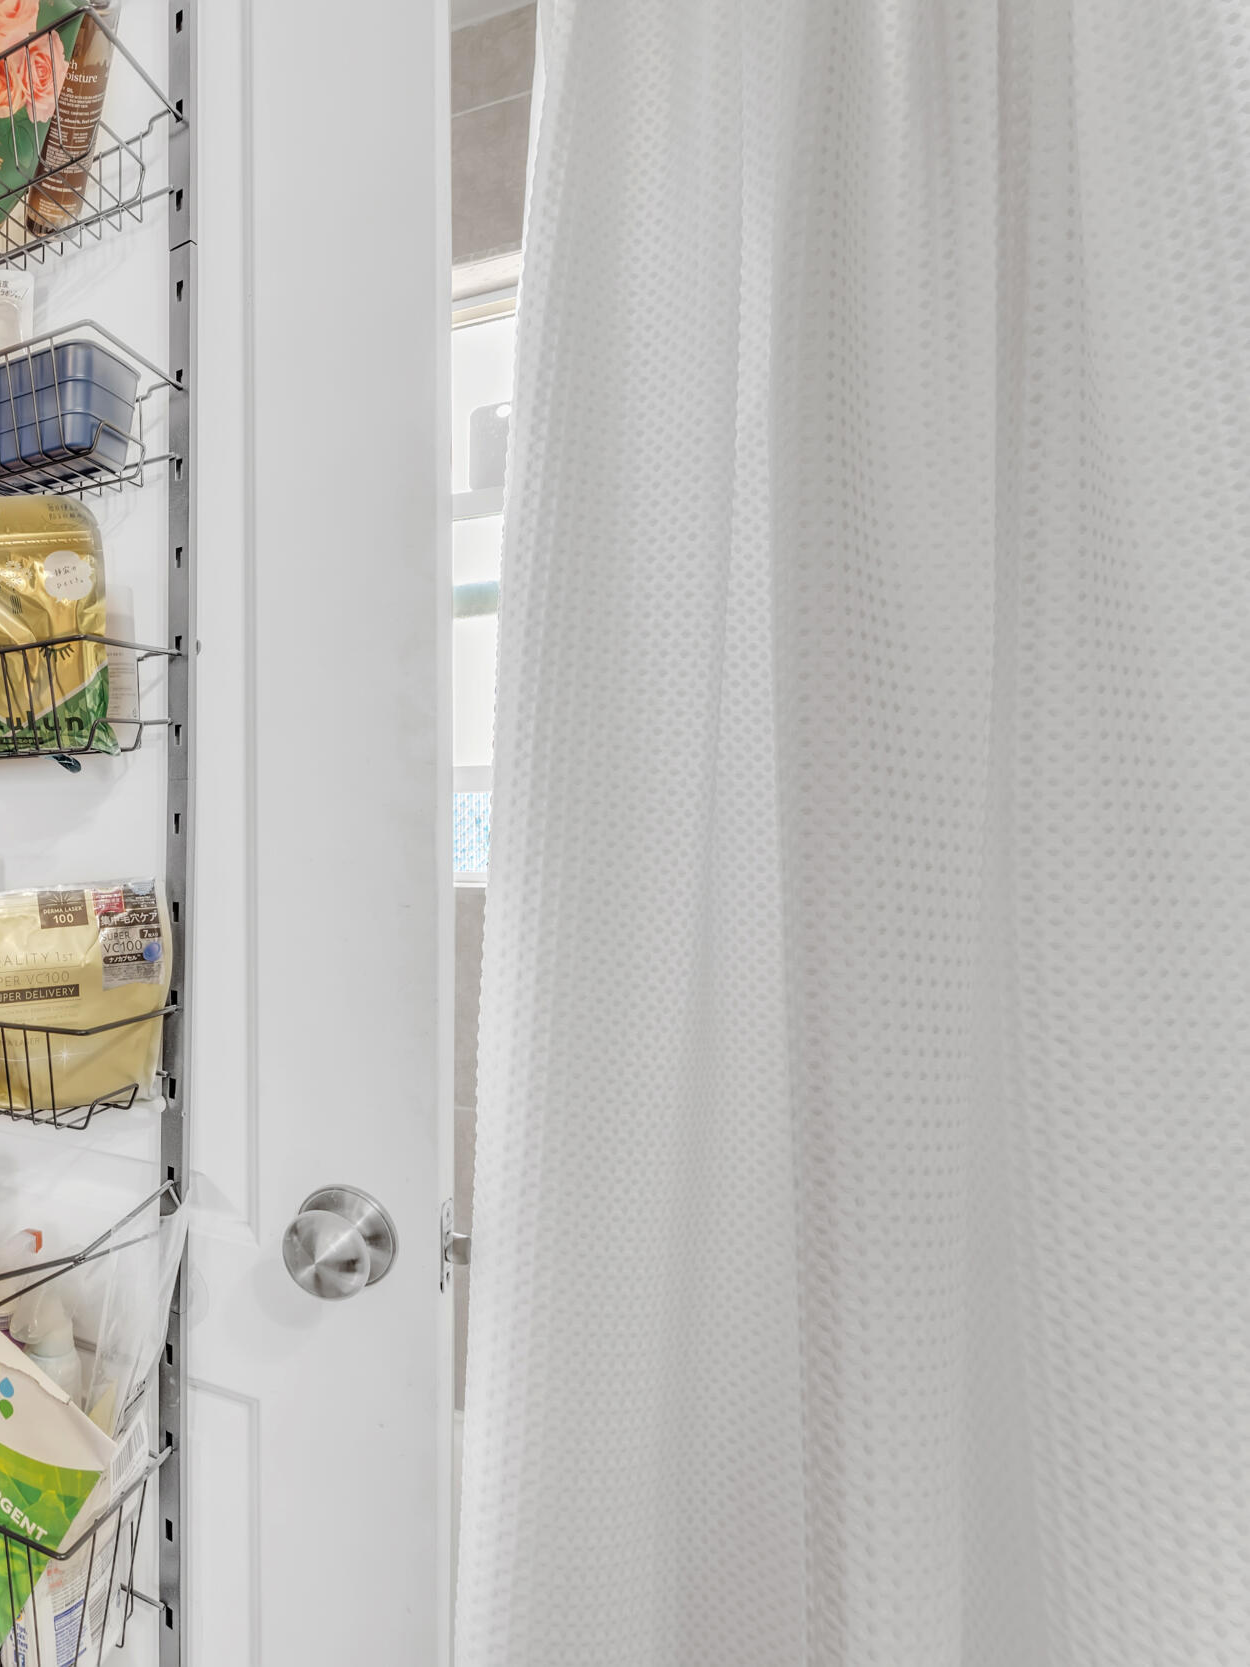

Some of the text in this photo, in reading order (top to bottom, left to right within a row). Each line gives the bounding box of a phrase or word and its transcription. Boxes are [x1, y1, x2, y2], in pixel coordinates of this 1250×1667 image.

[65, 71, 98, 83] oisture
[43, 906, 64, 915] DERMA
[53, 914, 74, 925] 100
[102, 931, 131, 942] SUPER
[103, 940, 143, 953] VC100
[26, 970, 70, 986] VC100
[25, 986, 76, 1000] DELIVERY
